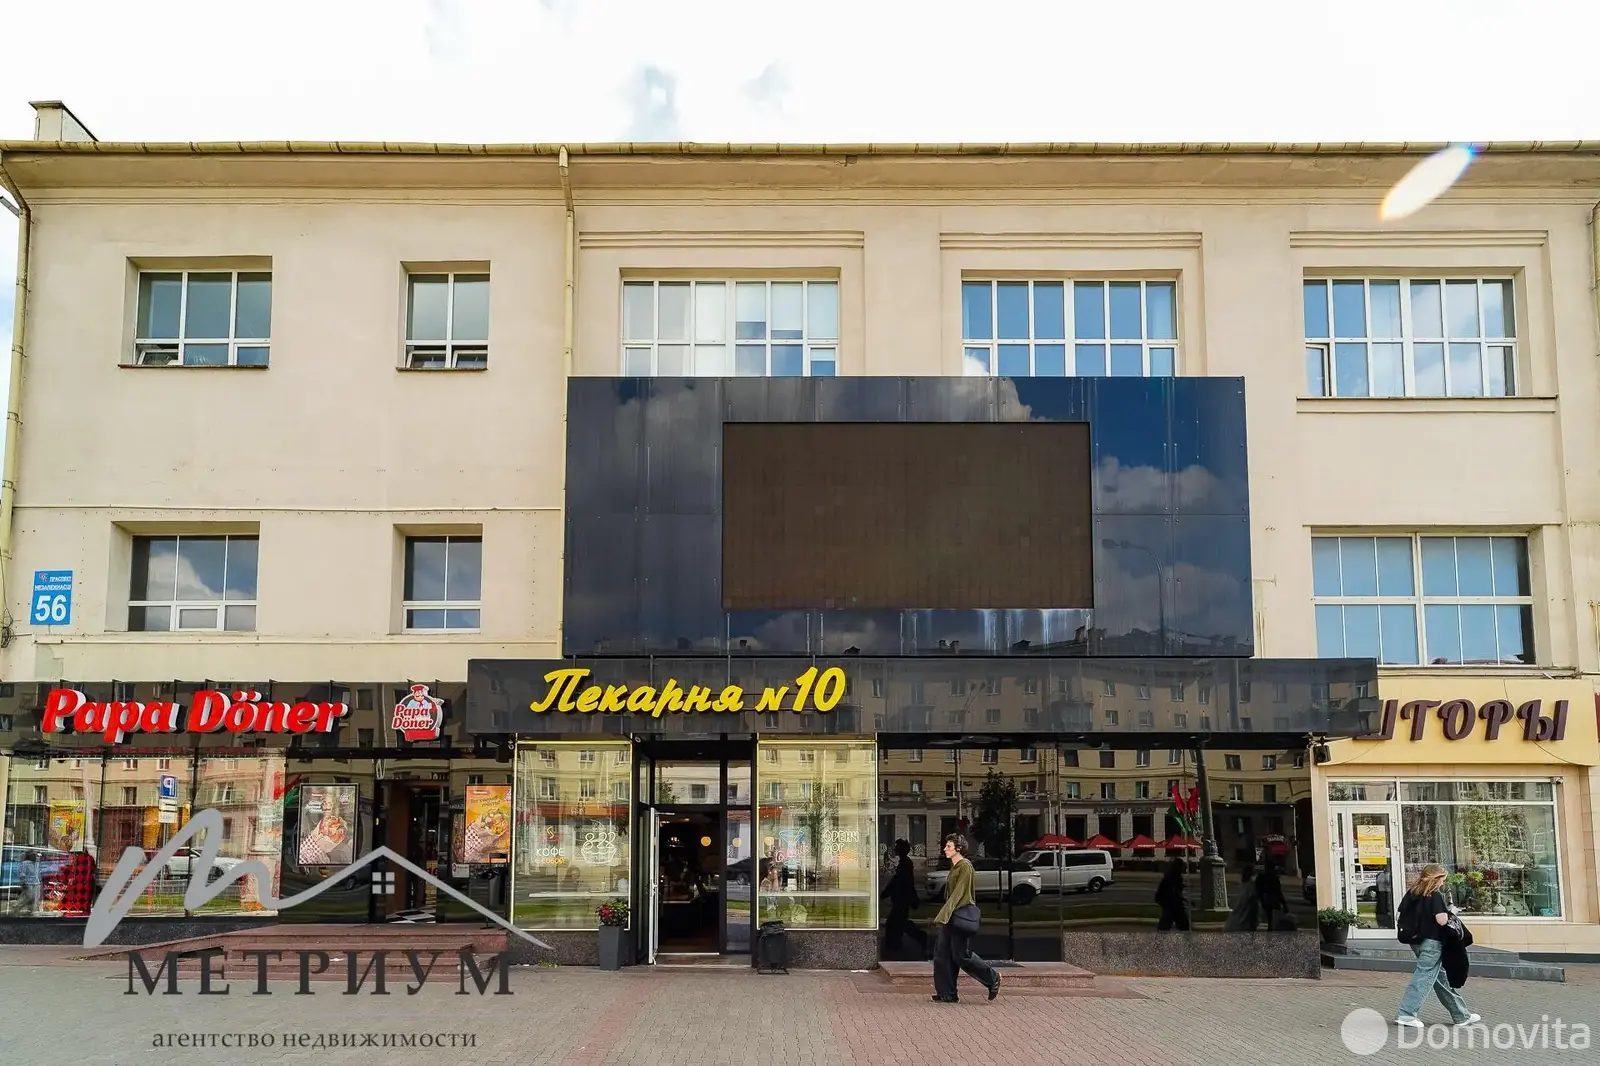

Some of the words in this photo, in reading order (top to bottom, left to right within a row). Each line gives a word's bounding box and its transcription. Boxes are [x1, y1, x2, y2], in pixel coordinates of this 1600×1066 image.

[35, 594, 67, 622] 56
[530, 668, 744, 718] Пекарня
[42, 688, 180, 744] Papa
[188, 689, 348, 733] Döner
[395, 704, 430, 719] Papa
[392, 716, 433, 729] Döner
[536, 846, 565, 857] КОФЕ
